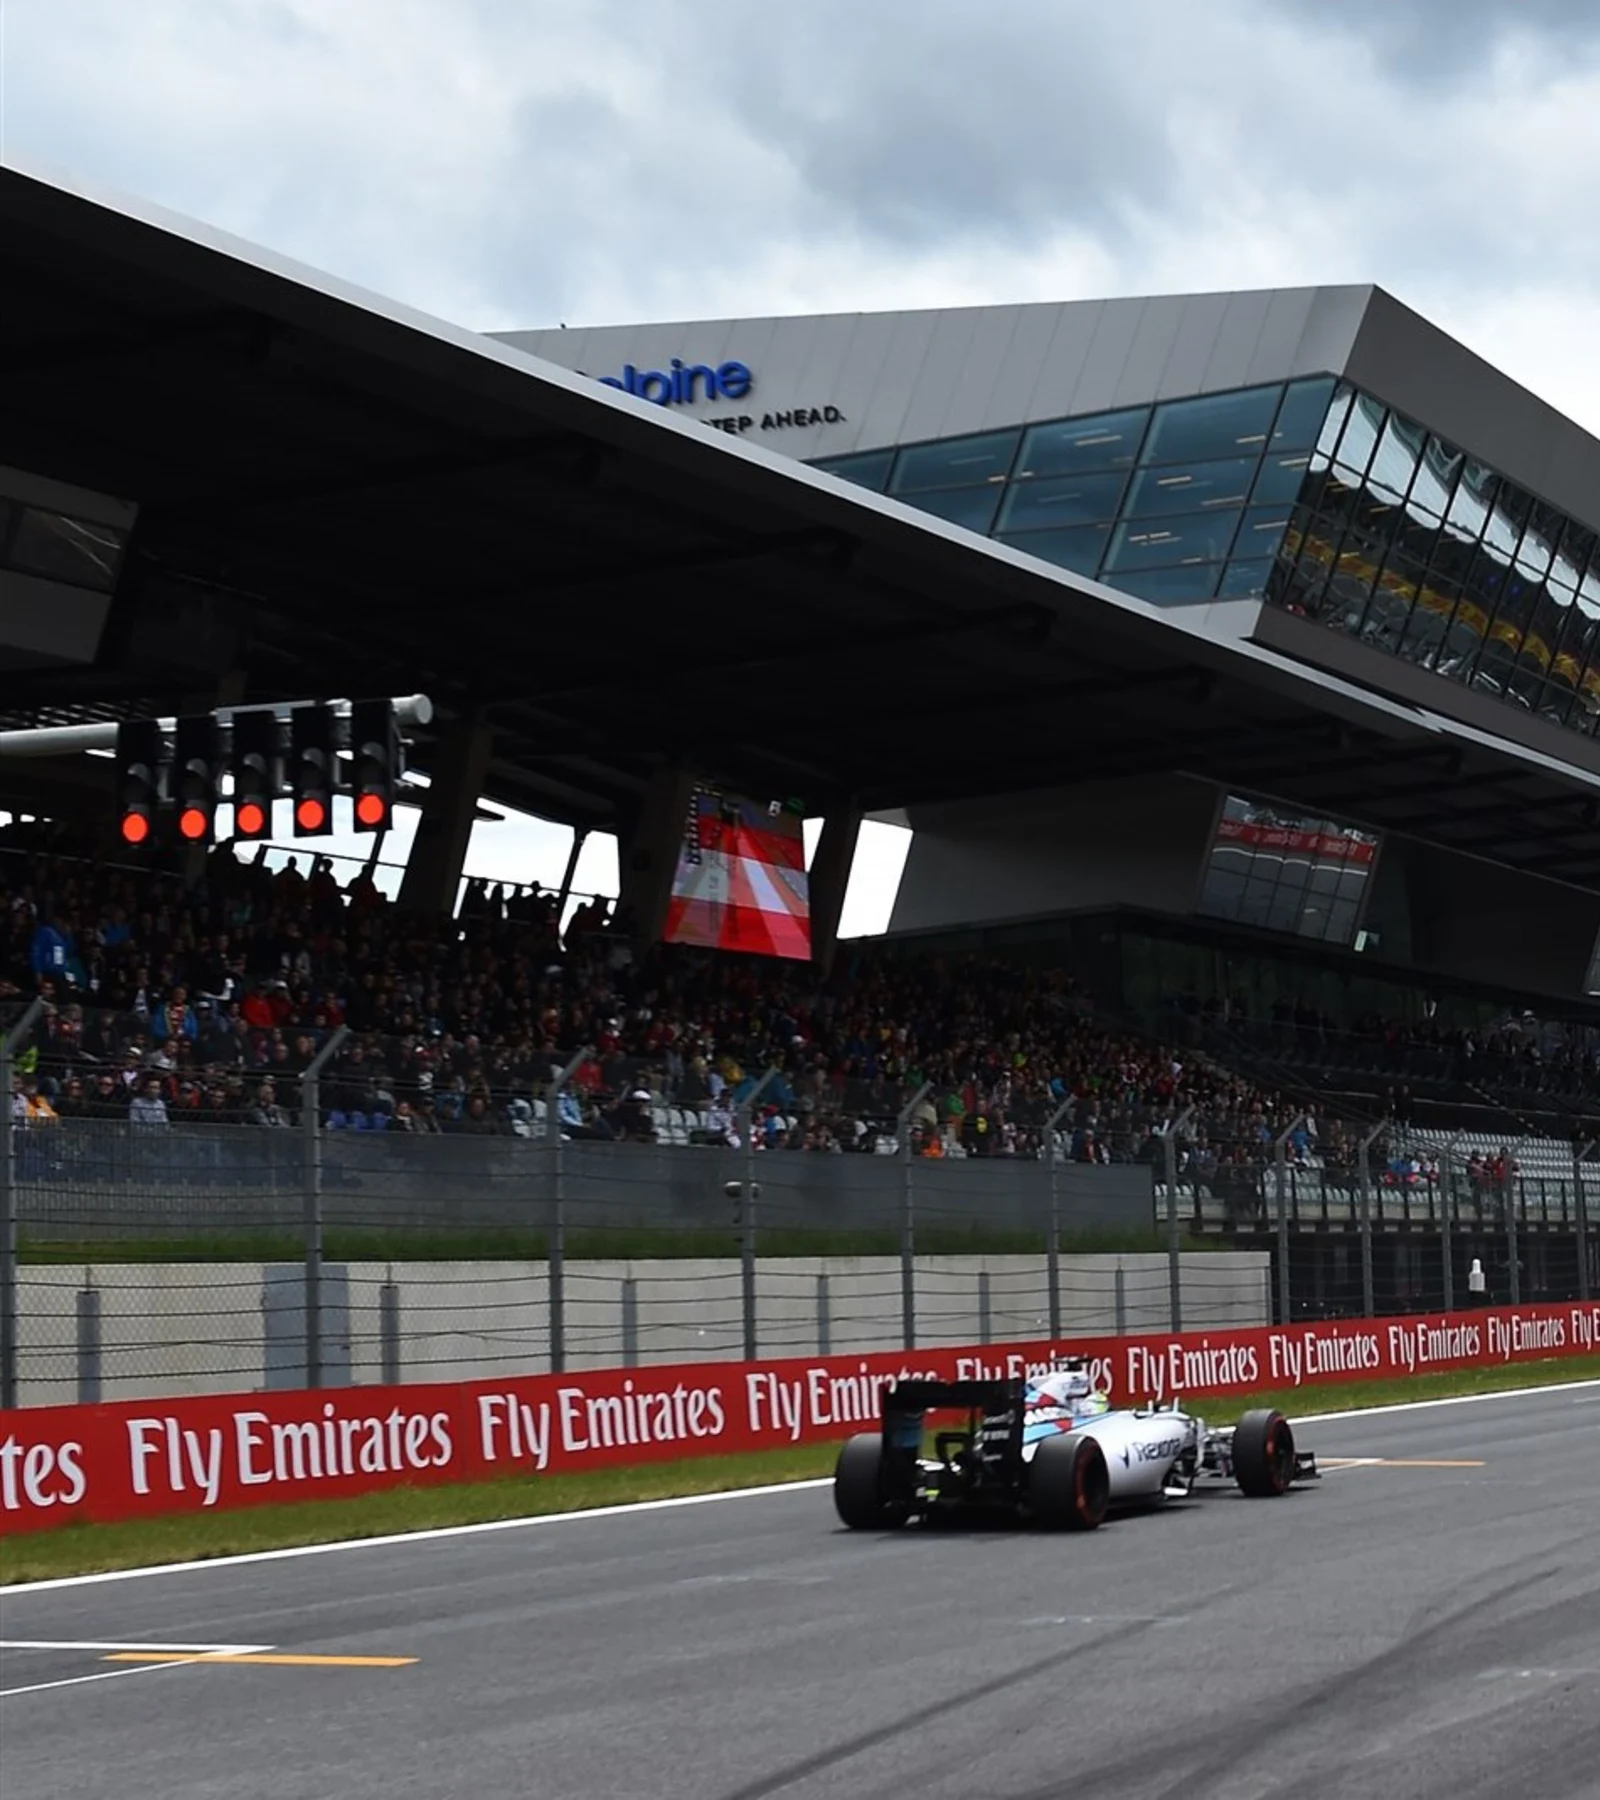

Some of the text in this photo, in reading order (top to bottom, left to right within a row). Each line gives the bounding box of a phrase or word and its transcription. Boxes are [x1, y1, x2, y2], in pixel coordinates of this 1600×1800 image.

[700, 405, 846, 435] TEP AHEAD.
[1268, 1328, 1380, 1385] Fly Emirates
[1388, 1320, 1480, 1373] Fly Emirates
[1487, 1312, 1565, 1360] Fly Emirates
[1571, 1310, 1592, 1350] Fly
[1128, 1340, 1259, 1400] Fly Emirates
[478, 1380, 725, 1470] Fly Emirates
[746, 1372, 801, 1441] Fly
[126, 1403, 453, 1506] Fly Emirates
[1134, 1438, 1180, 1463] Rexona
